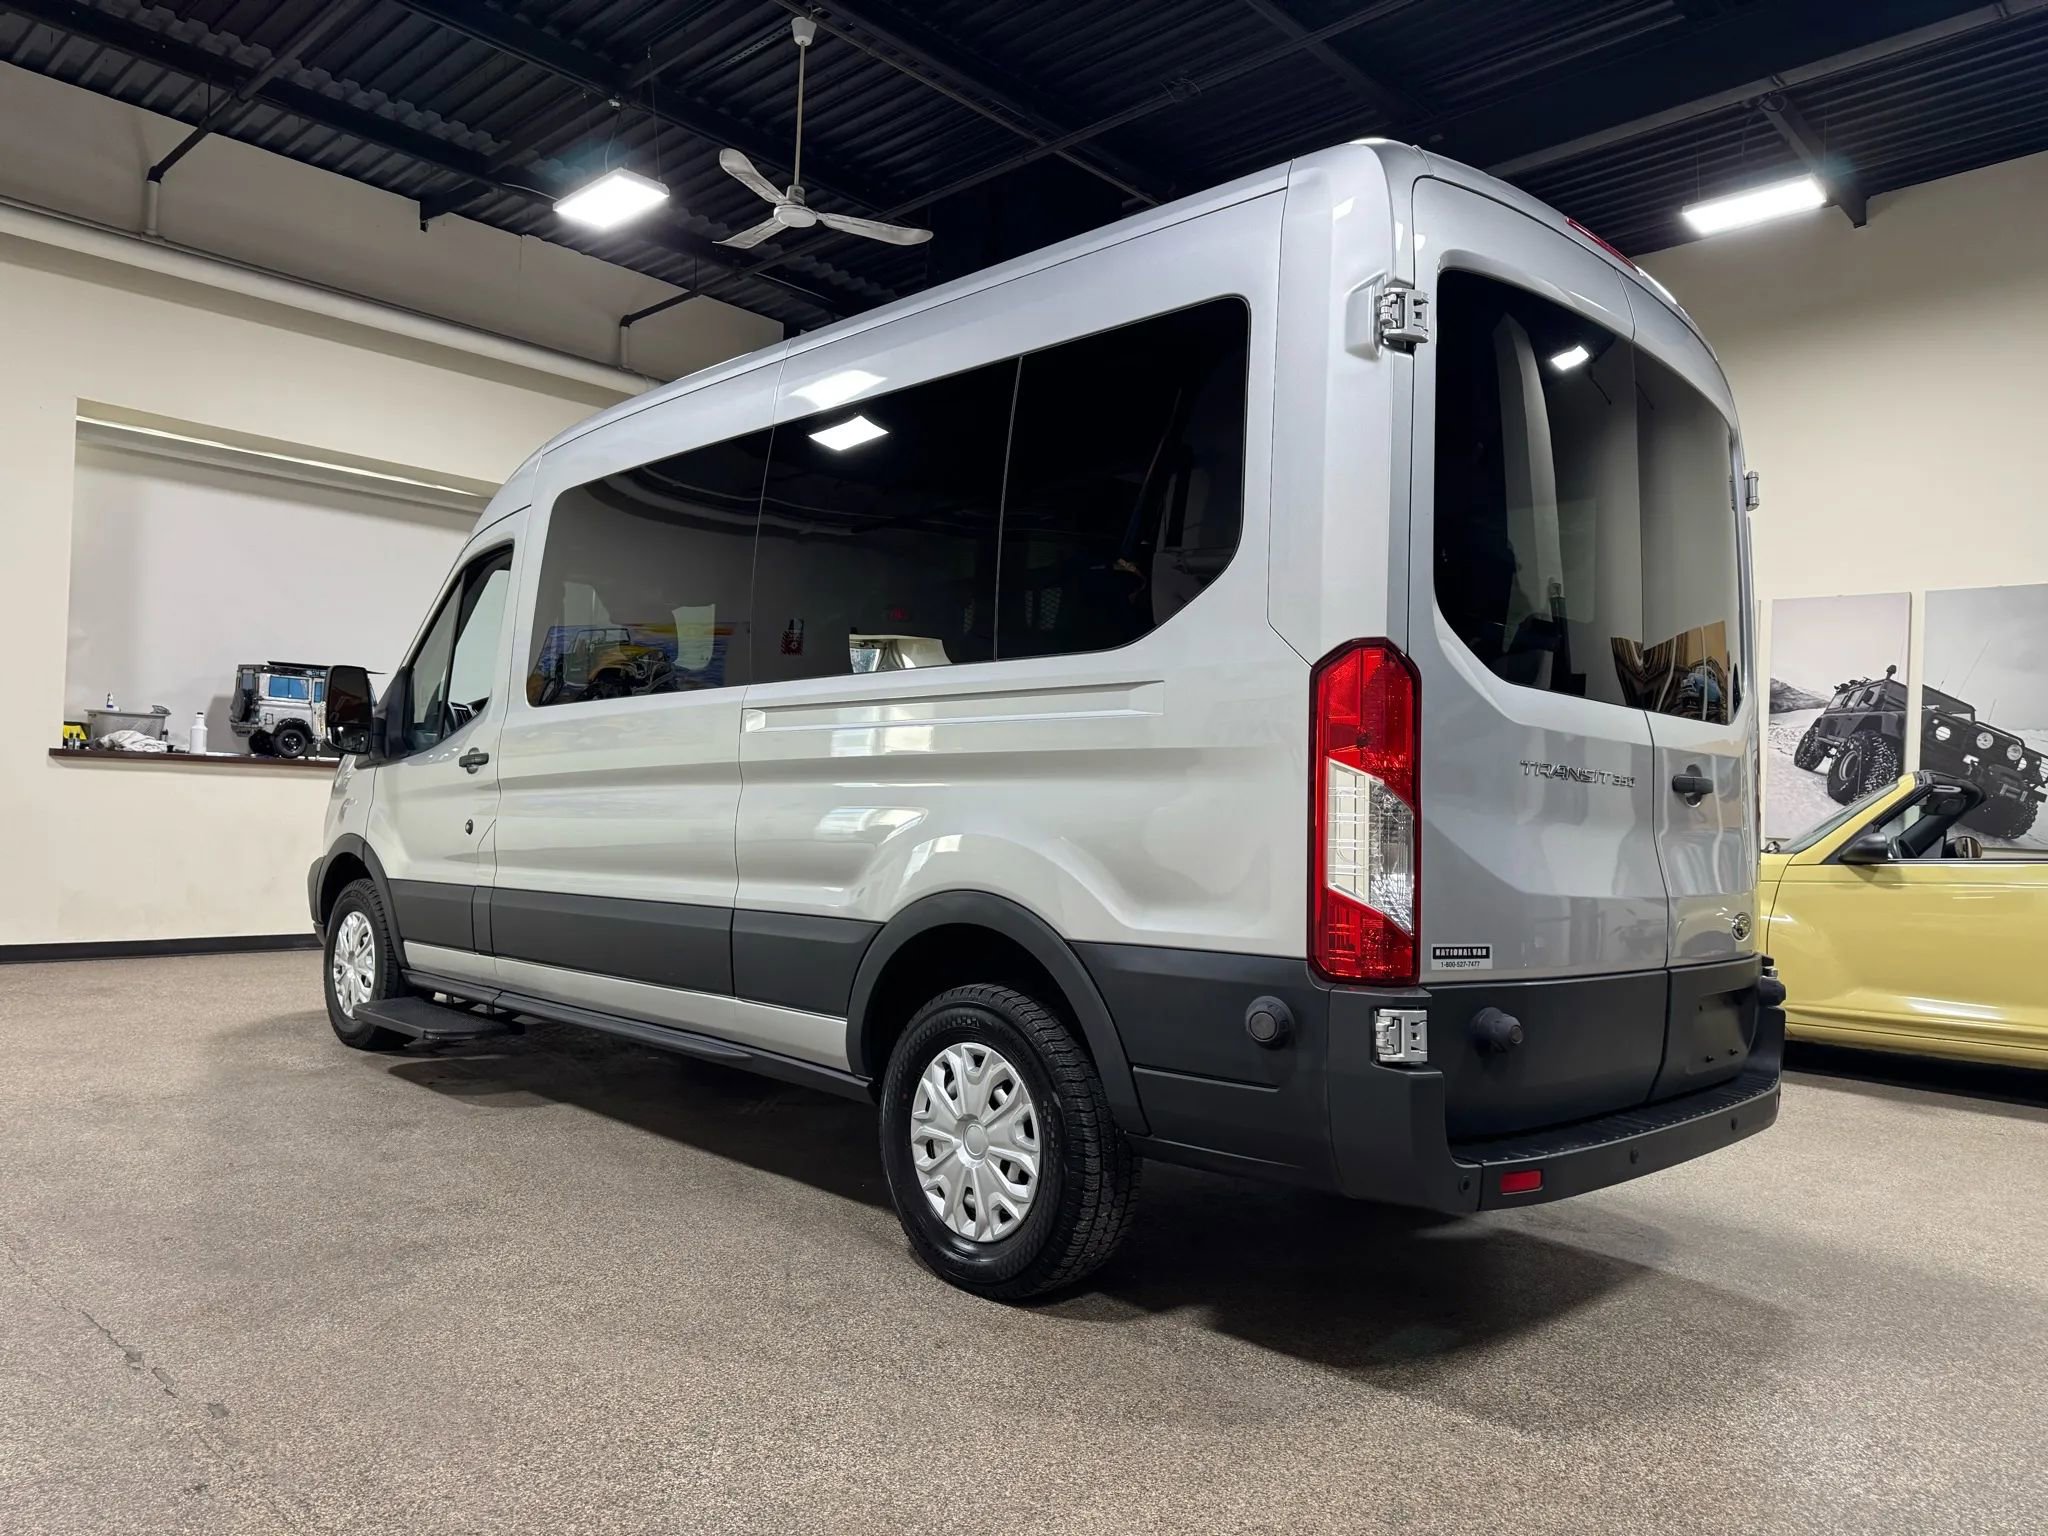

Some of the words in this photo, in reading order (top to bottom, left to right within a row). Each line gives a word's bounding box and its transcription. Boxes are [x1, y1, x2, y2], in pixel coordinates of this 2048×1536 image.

[1520, 760, 1612, 784] TRANSIT
[1435, 948, 1471, 956] NATIONAL
[1472, 948, 1487, 956] VAN
[1441, 960, 1481, 968] 1-800-527-7477
